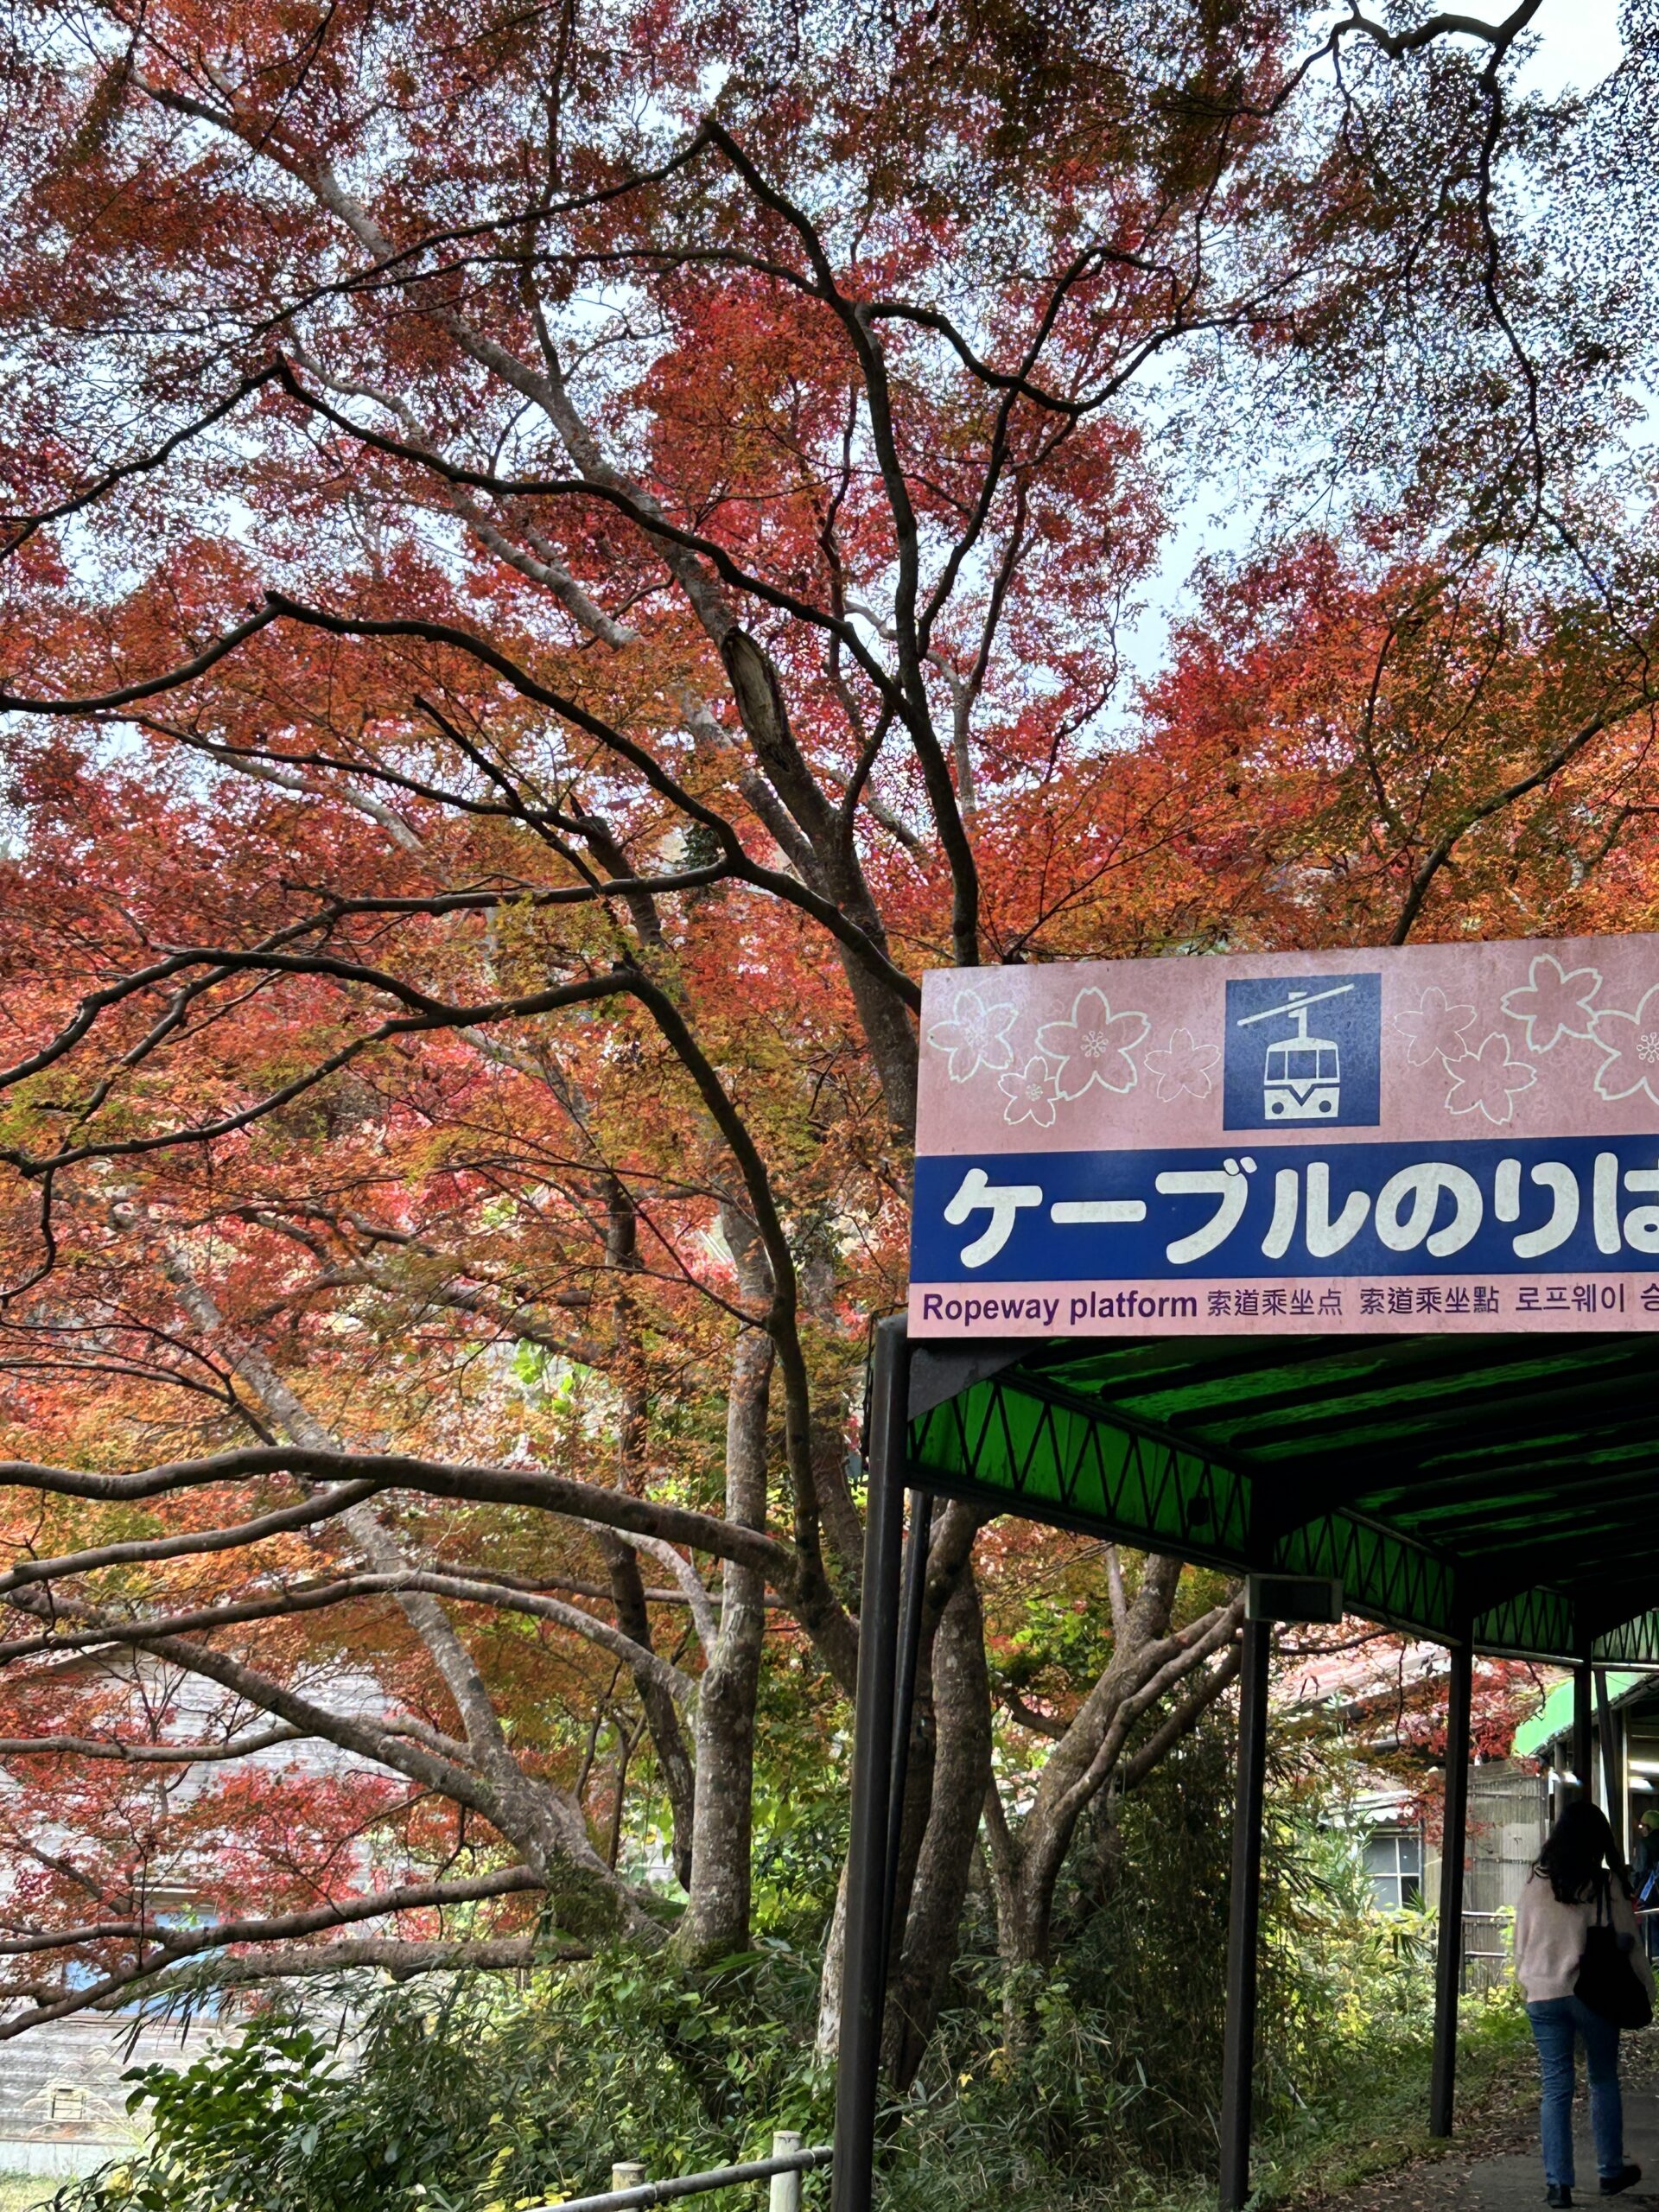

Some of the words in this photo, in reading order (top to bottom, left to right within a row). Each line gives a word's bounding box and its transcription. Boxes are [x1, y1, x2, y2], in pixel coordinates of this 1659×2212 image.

[923, 1293, 1059, 1326] Ropeway
[1070, 1290, 1198, 1325] platform
[1207, 1288, 1343, 1317] 索道乘坐点
[1359, 1286, 1499, 1315] 索道乘坐點
[1516, 1283, 1624, 1313] 로프웨이
